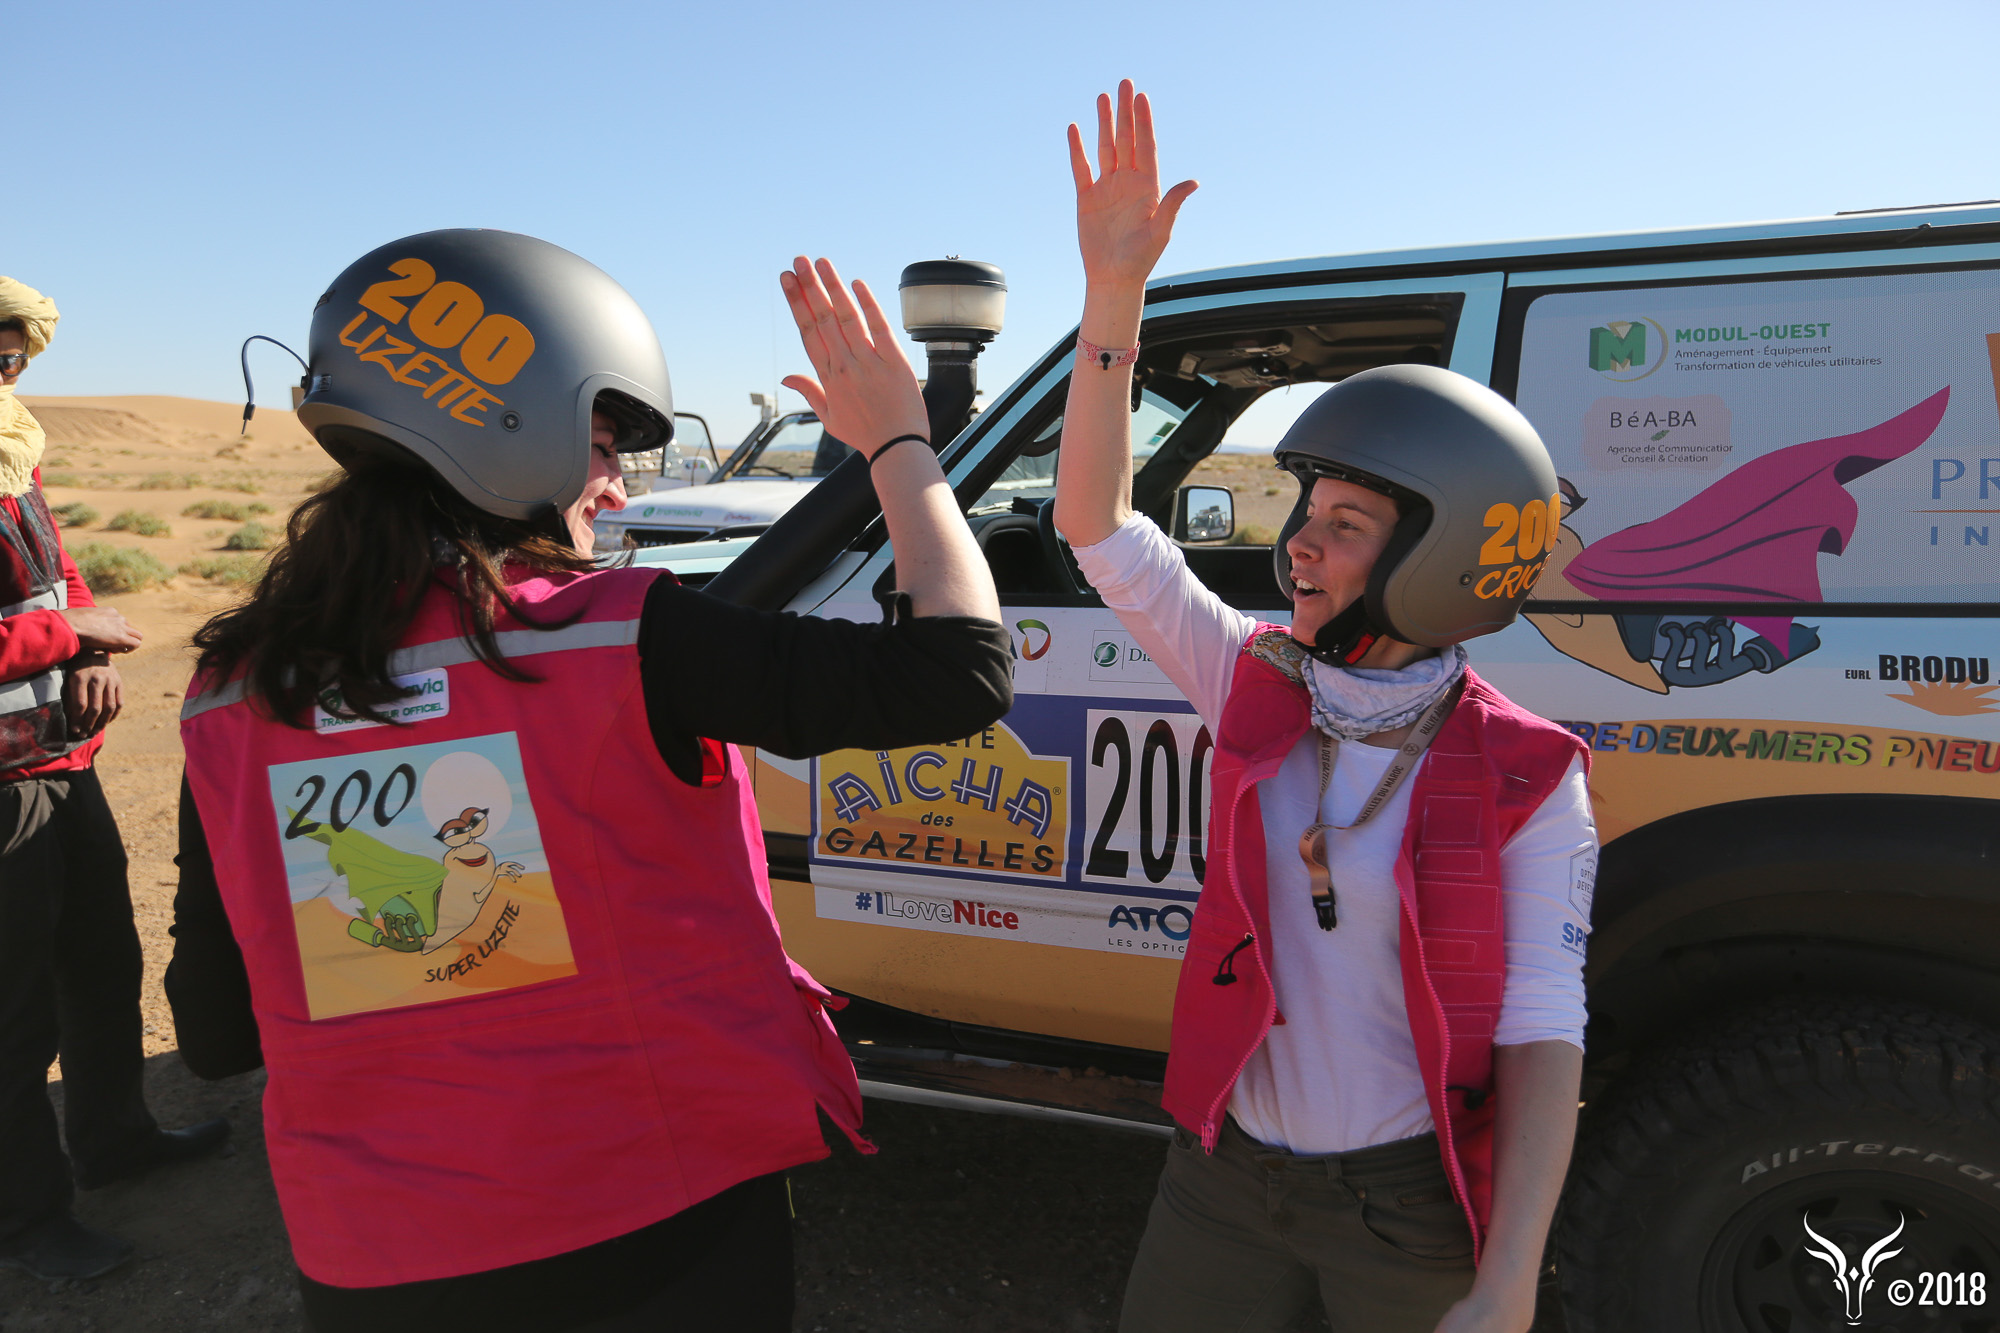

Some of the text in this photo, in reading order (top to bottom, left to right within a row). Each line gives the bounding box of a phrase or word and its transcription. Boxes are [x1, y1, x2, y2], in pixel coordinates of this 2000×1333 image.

[358, 257, 535, 385] 200
[1675, 322, 1831, 343] MODUL-OUEST
[338, 310, 505, 427] LIZETTE
[1675, 348, 1754, 359] Aménagement
[1763, 345, 1832, 357] Équipement
[1675, 355, 1882, 371] Transformation de véhicules utilitaires
[1607, 445, 1641, 455] Agence
[1644, 444, 1656, 453] de
[1621, 453, 1708, 463] Conseil & Création
[1479, 492, 1560, 566] 200
[1474, 554, 1551, 600] CRIC
[1845, 654, 1989, 685] EURL BRODU
[403, 702, 444, 717] OFFICIEL
[1880, 737, 2000, 774] PNEU
[1377, 787, 1389, 798] DU
[1384, 765, 1405, 788] MAROC
[285, 762, 417, 840] 200
[1085, 716, 1214, 886] 200
[920, 811, 954, 828] des
[825, 827, 1055, 873] GAZELLES
[1108, 904, 1195, 941] ATO
[424, 899, 520, 983] SUPER LIZETTE
[1108, 938, 1185, 953] LES OPTIC
